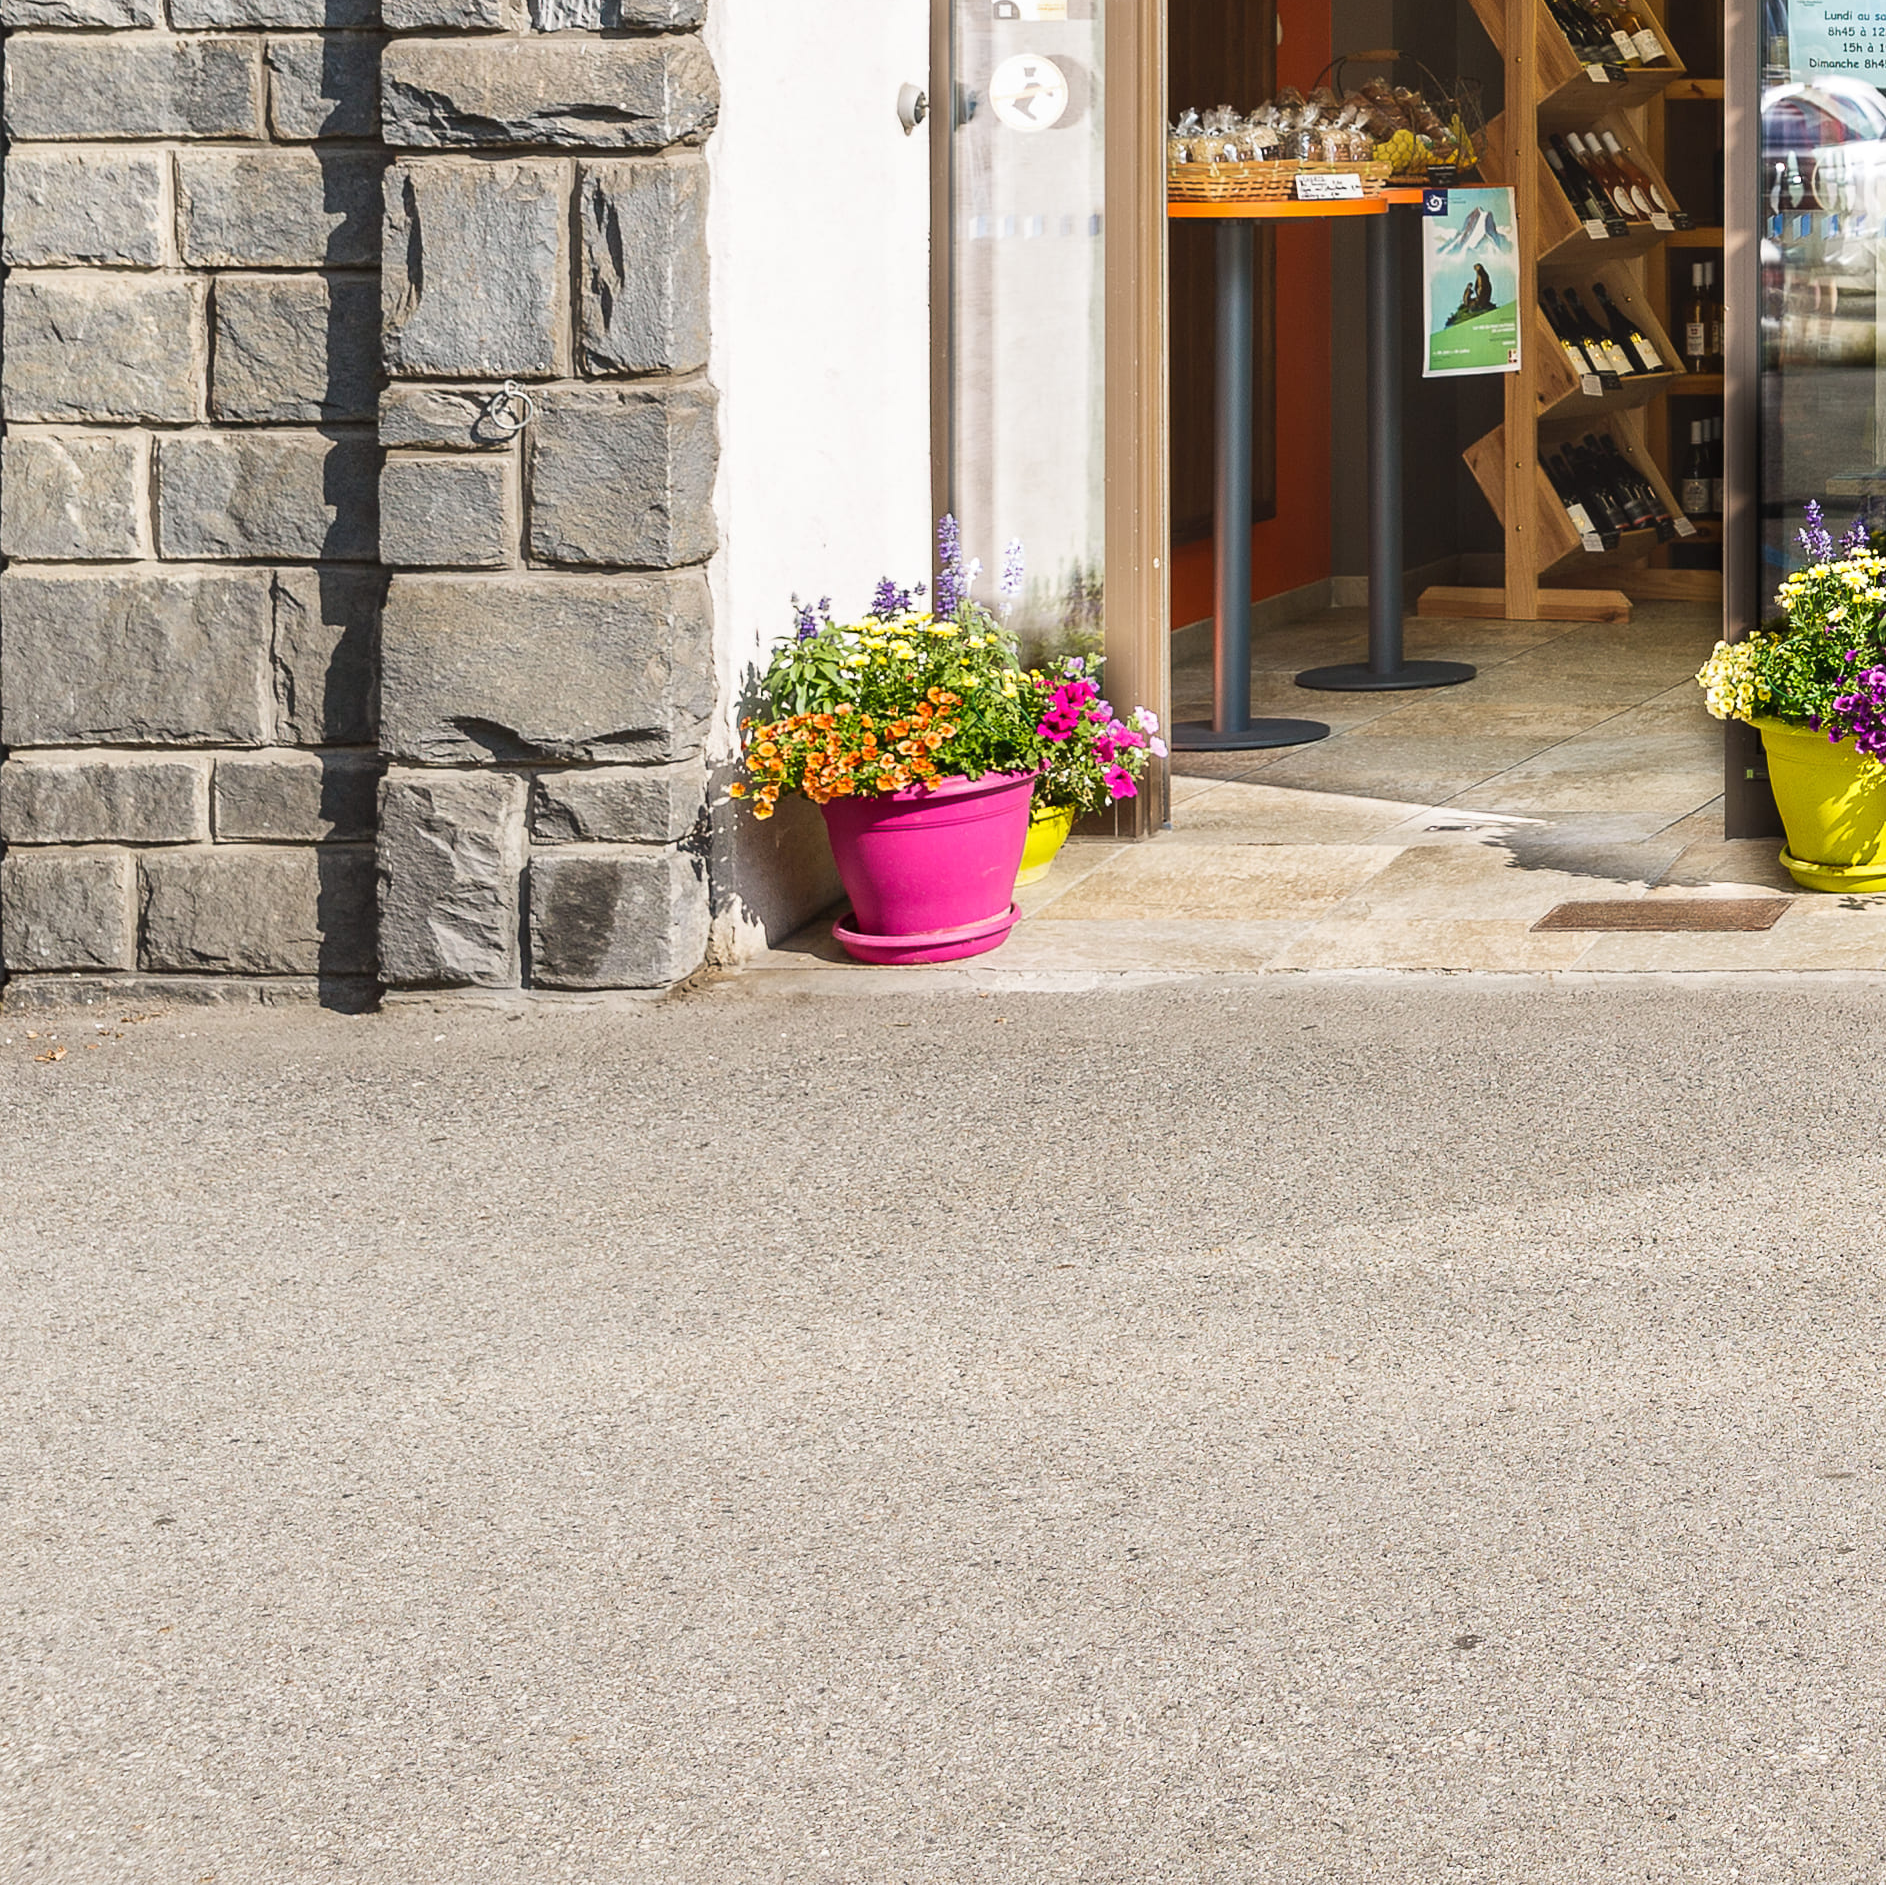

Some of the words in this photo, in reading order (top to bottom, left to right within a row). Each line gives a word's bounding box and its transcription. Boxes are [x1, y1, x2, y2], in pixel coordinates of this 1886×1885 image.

[1825, 11, 1852, 21] Lundi
[1858, 13, 1870, 21] au
[1828, 27, 1855, 37] 8h45
[1860, 26, 1866, 36] à
[1843, 43, 1862, 53] 15h
[1868, 43, 1873, 52] à
[1809, 59, 1859, 68] Dimanche
